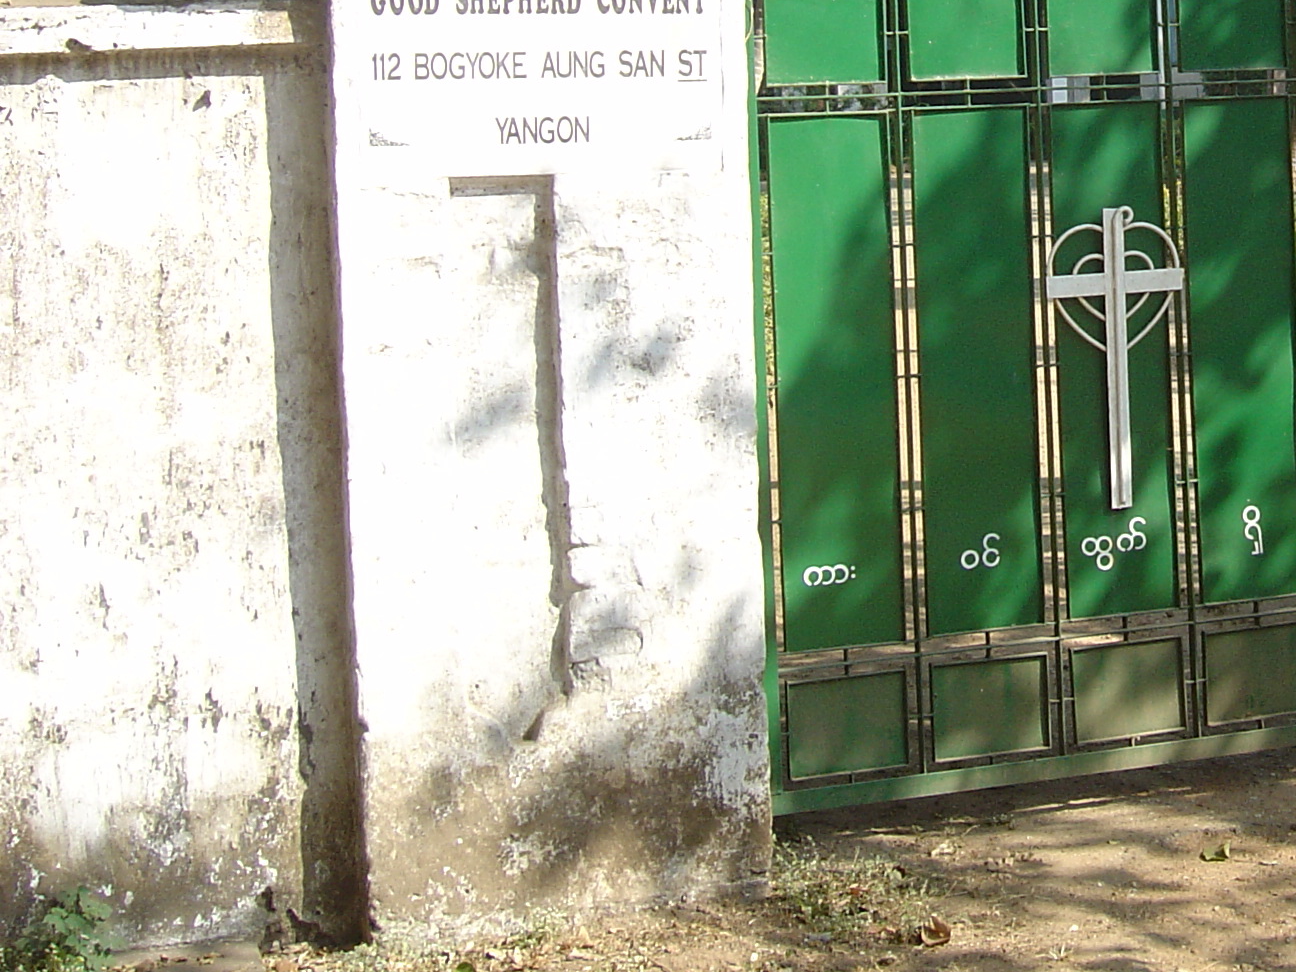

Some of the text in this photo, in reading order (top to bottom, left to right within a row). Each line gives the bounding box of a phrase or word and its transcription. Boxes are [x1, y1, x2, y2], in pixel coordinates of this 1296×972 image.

[371, 49, 708, 81] 112 BOGYOKE AUNG SAN ST
[494, 115, 591, 146] YANGON
[802, 562, 857, 587] ကား
[1080, 515, 1148, 572] ထွက်
